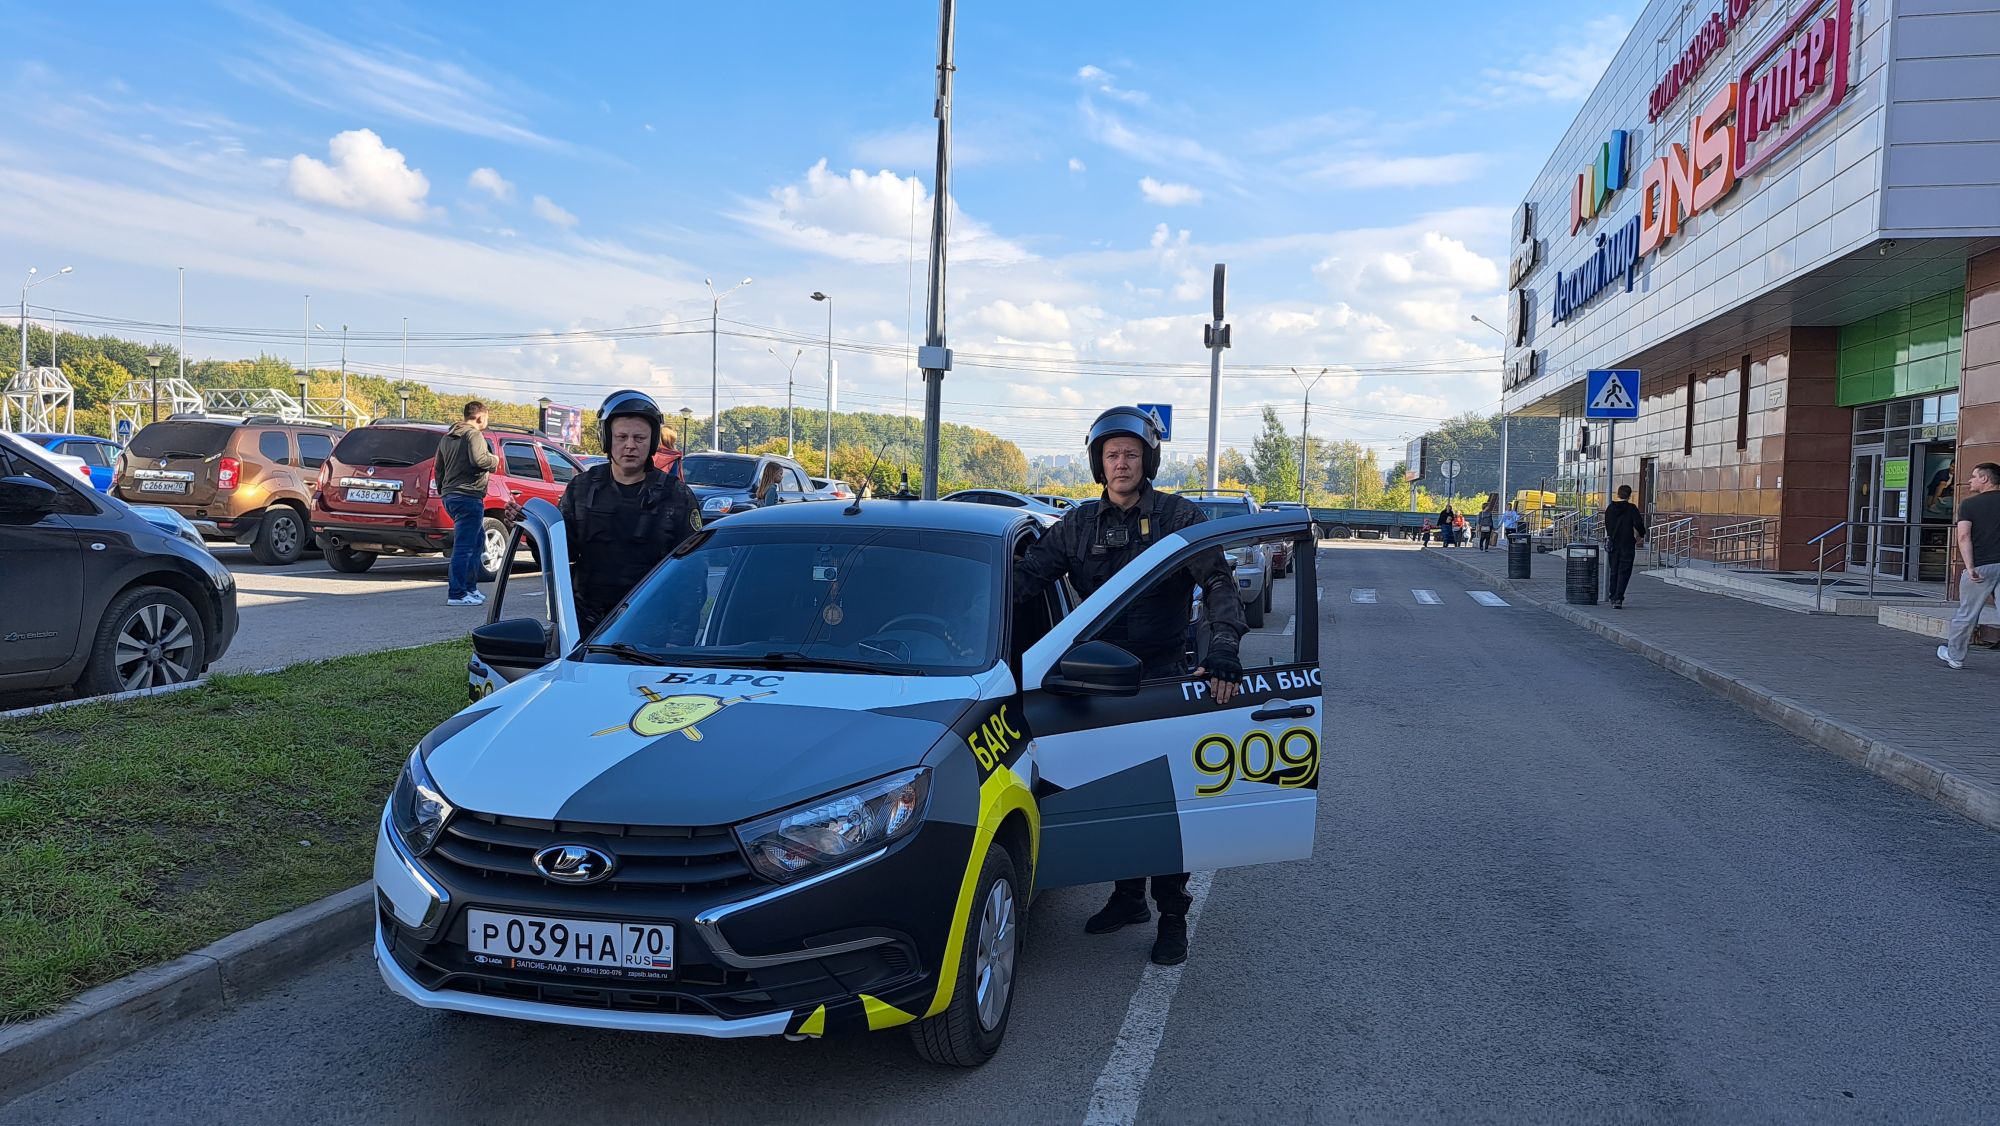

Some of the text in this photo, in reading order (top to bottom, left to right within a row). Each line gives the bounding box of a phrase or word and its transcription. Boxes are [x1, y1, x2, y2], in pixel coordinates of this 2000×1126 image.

[1648, 63, 1680, 124] ЕСЛИ
[1678, 12, 1726, 83] ОБУВЬ,
[1743, 17, 1836, 142] ГИПЕР
[1639, 82, 1738, 258] DNS
[1552, 232, 1606, 327] Детский
[349, 490, 381, 500] К438СХ
[655, 672, 785, 689] БАРС
[1180, 674, 1273, 701] ГРПА
[967, 703, 1022, 772] БАРС
[1191, 726, 1321, 798] 909
[482, 919, 664, 963] Р039НА 70
[516, 961, 568, 973] ЗАПСИБ-ЛАДА
[625, 954, 651, 966] RUS
